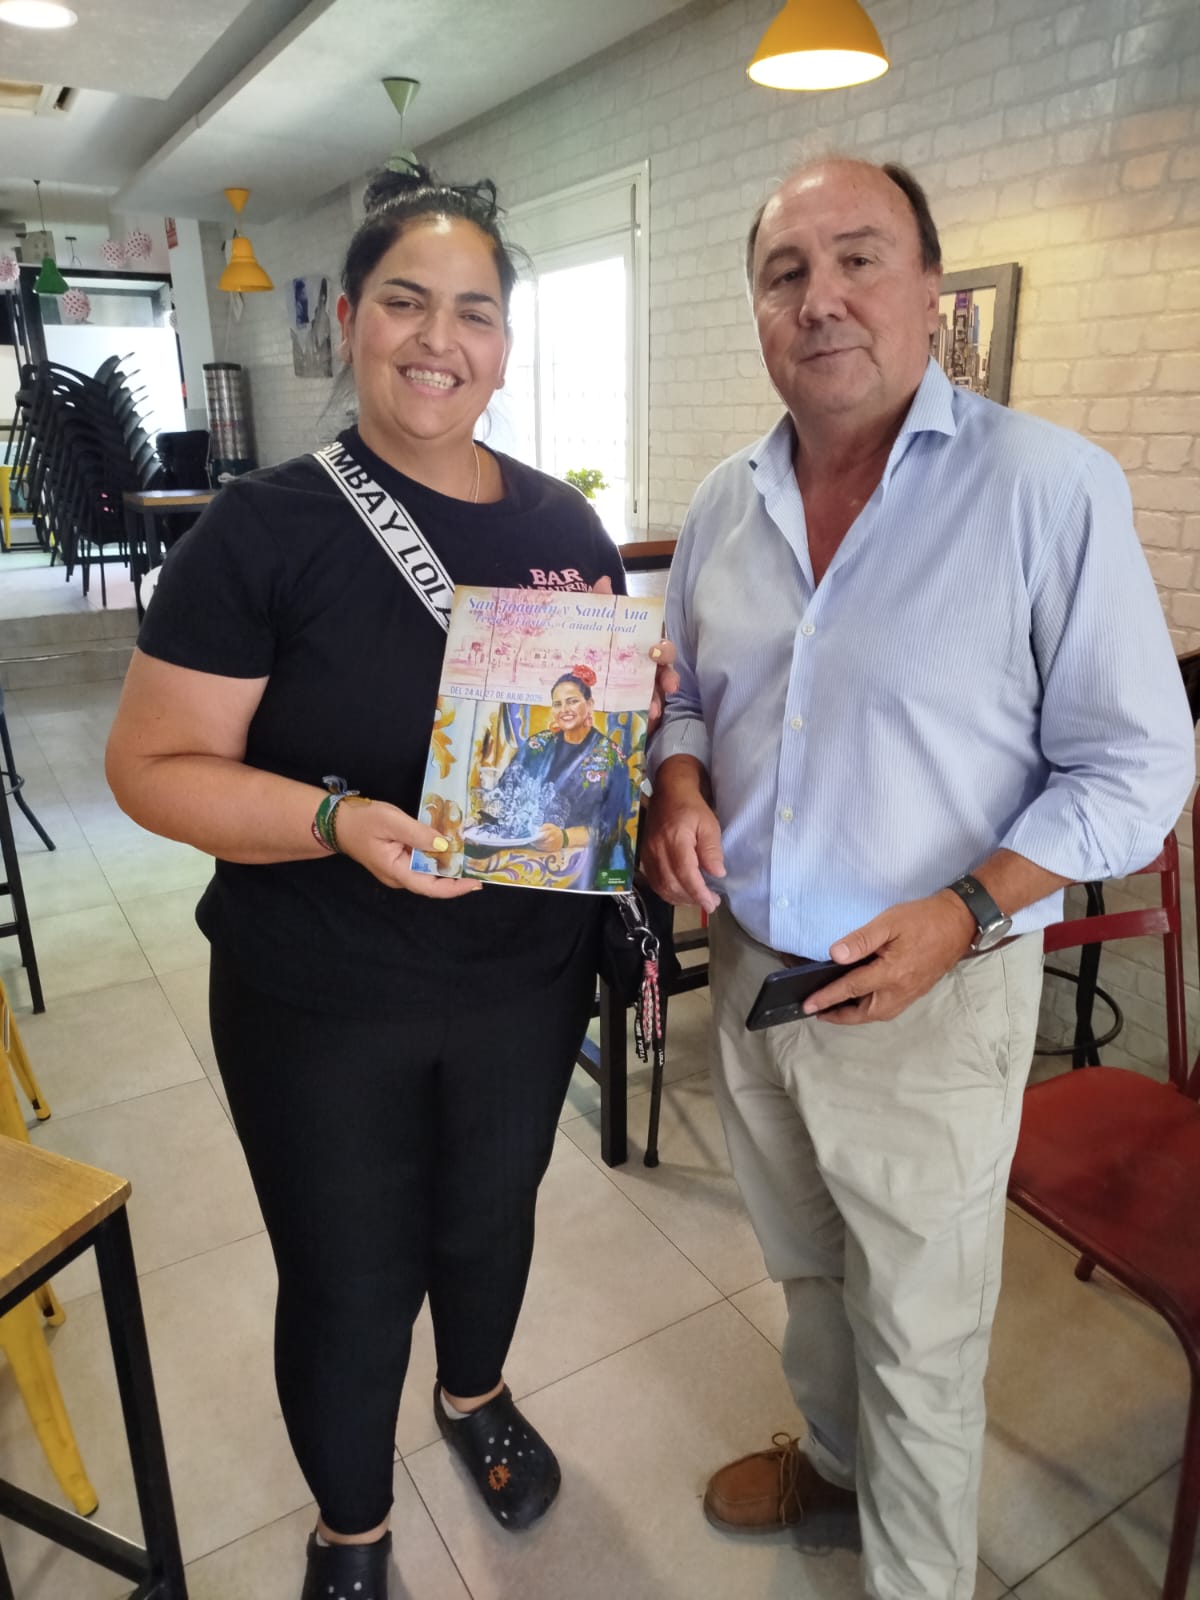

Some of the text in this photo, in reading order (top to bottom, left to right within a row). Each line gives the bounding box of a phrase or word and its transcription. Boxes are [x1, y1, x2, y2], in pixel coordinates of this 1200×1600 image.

[379, 510, 409, 531] Y
[529, 568, 584, 586] BAR
[469, 598, 494, 610] San
[575, 605, 616, 619] Santa
[624, 608, 649, 621] Ana
[606, 623, 637, 633] Rosal
